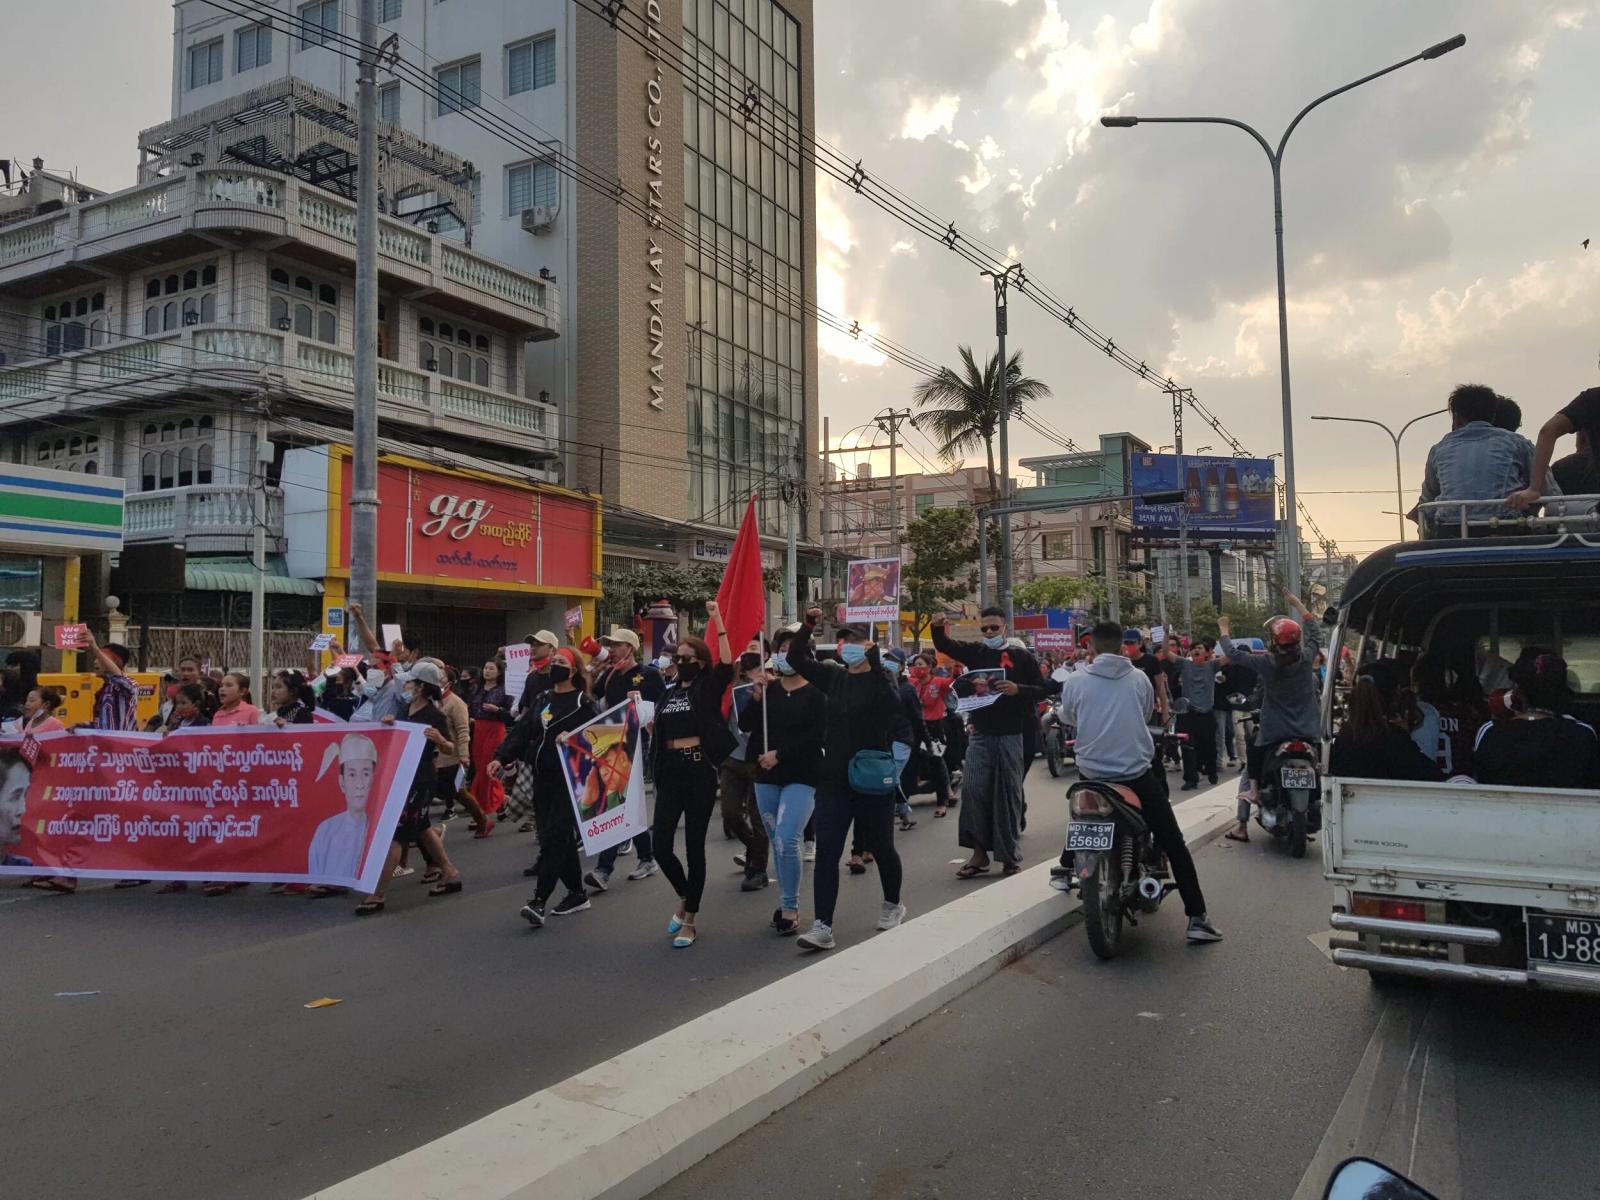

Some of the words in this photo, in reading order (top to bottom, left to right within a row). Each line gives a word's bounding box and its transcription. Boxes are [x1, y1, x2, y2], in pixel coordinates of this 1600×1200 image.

[647, 67, 664, 128] CO.,
[648, 136, 663, 228] STARS
[648, 236, 664, 411] MANDALAY
[421, 494, 494, 540] gg
[509, 648, 530, 660] Free
[142, 779, 248, 808] စစ်အာဏာရှင်စနစ်
[251, 778, 299, 808] အလိုမရှိ
[124, 814, 180, 843] လွှတ်တော်
[182, 814, 261, 844] ချက်ချင်းခေါ်
[1069, 836, 1108, 847] 55690
